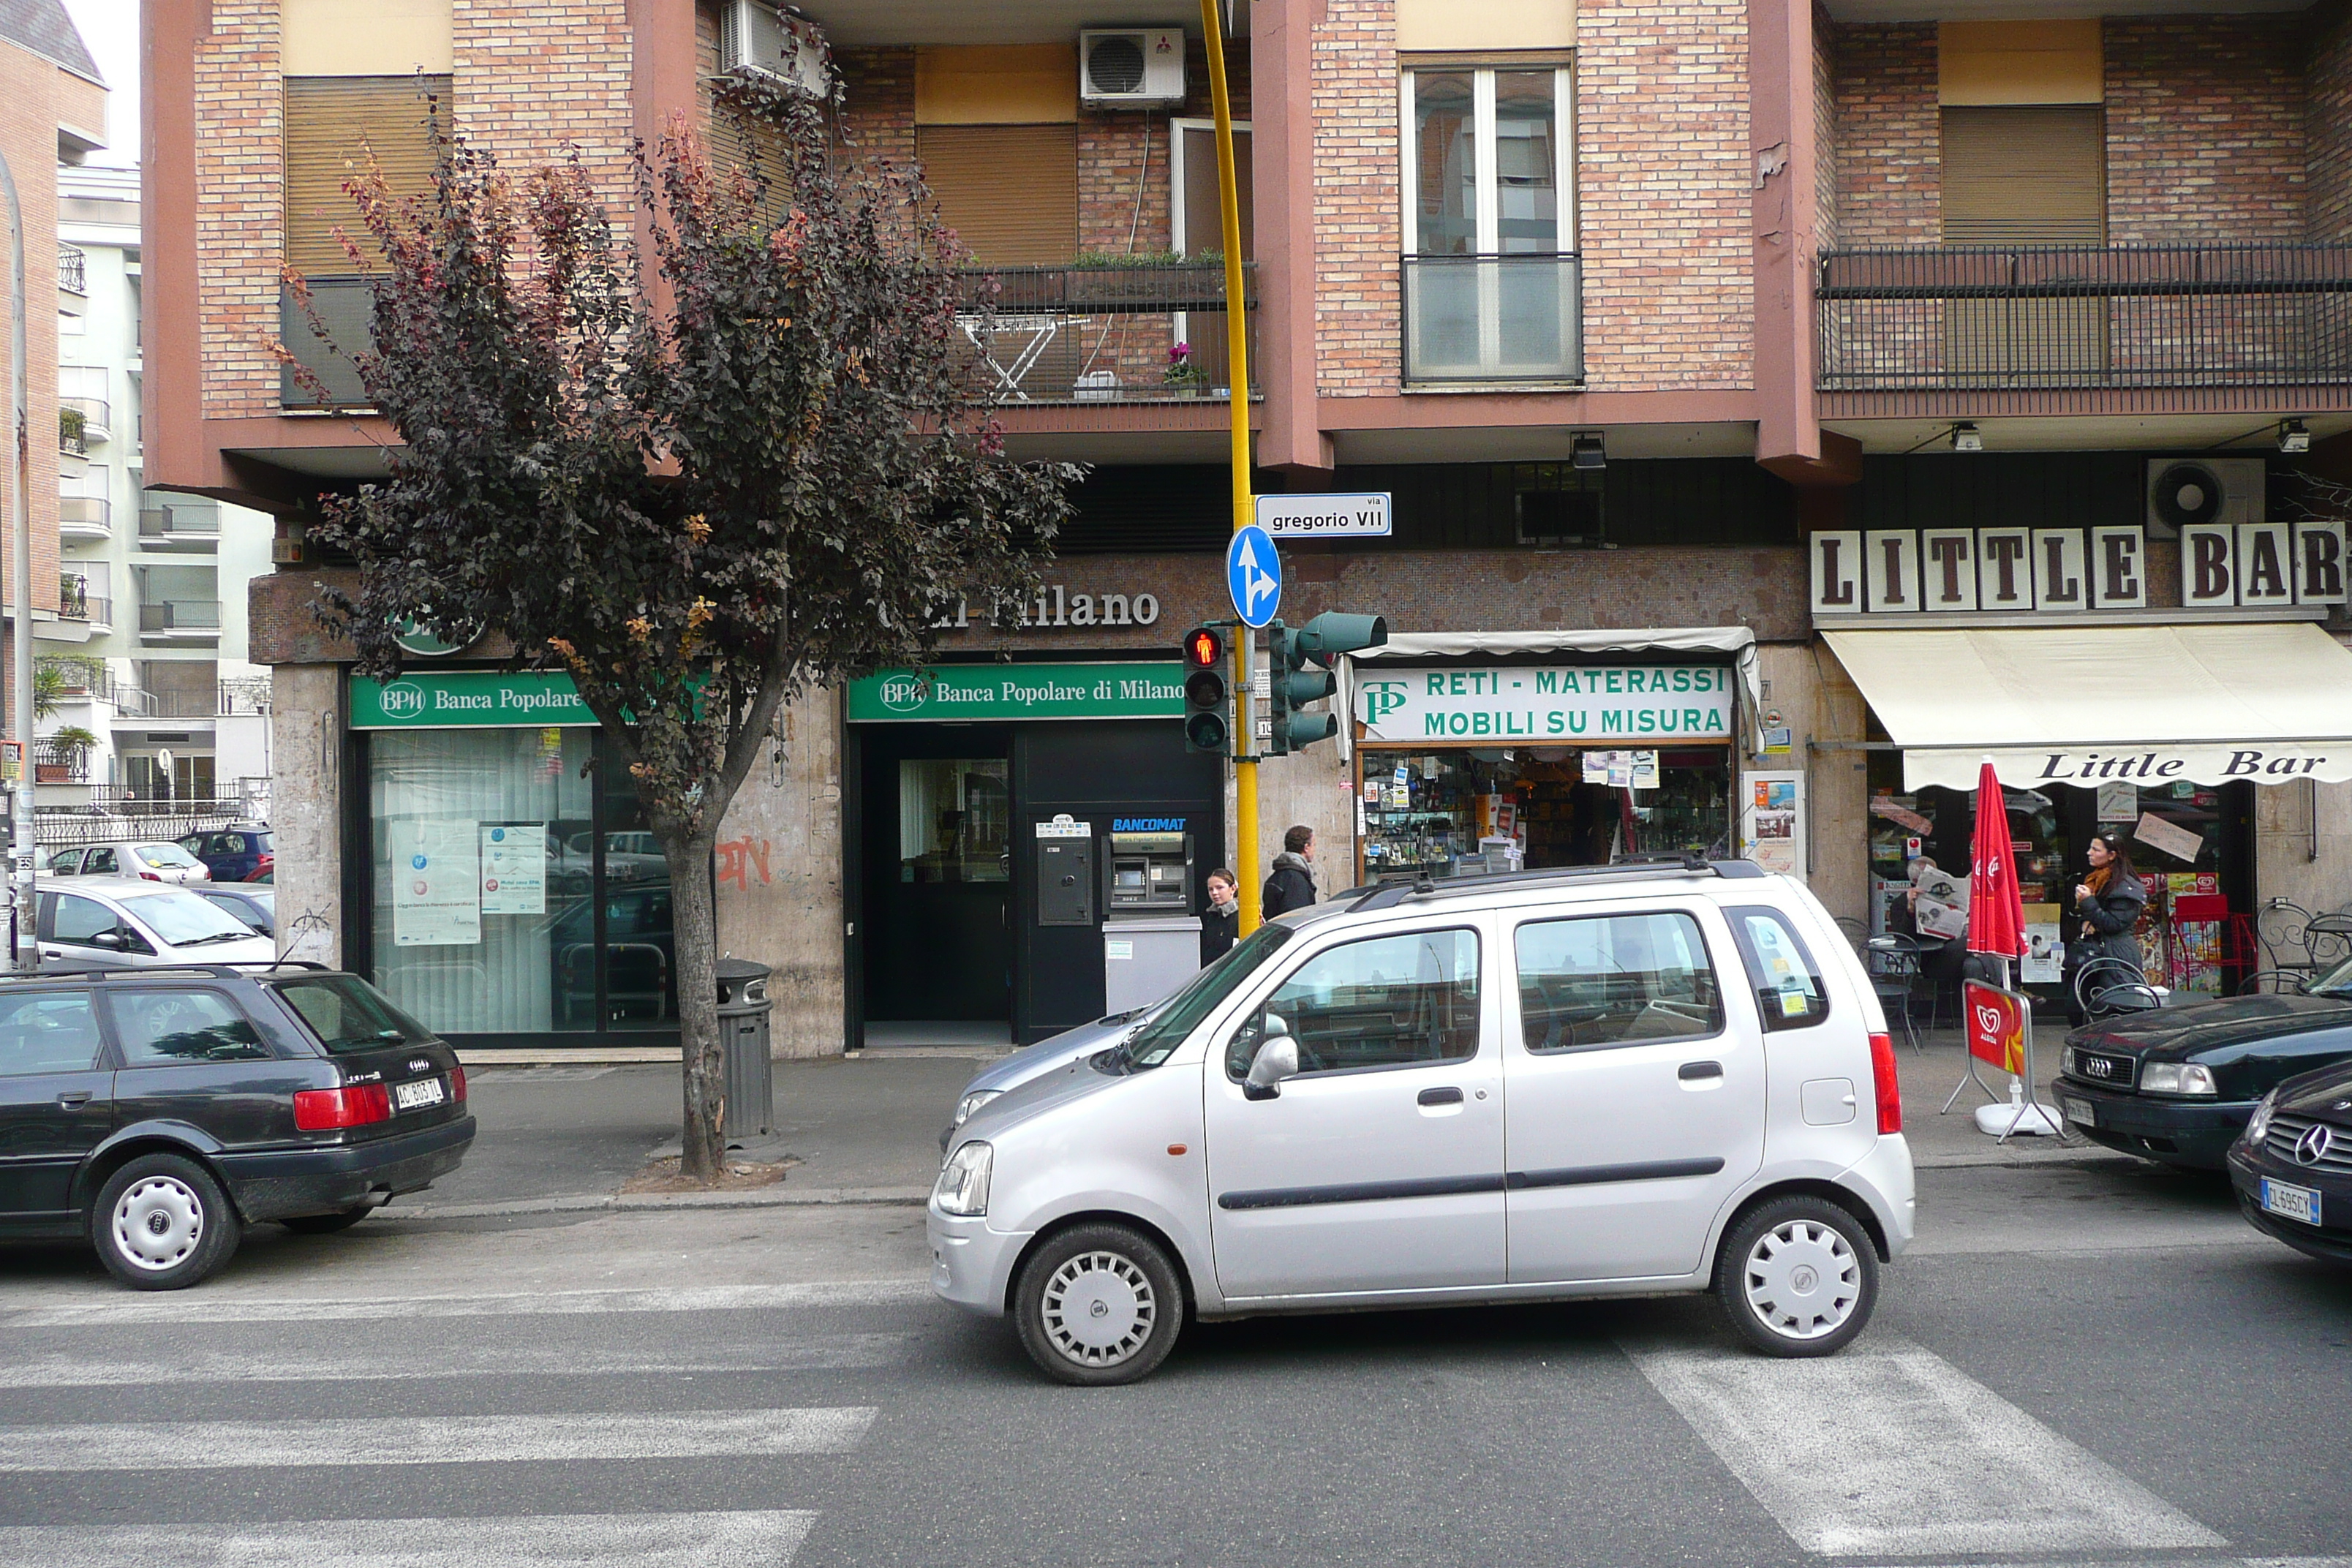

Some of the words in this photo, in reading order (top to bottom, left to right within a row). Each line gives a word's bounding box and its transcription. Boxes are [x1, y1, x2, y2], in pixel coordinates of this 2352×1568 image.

[1367, 497, 1381, 505] via
[1273, 513, 1349, 531] gregorio
[1357, 511, 1382, 527] VII
[1820, 534, 2138, 604] LITTLE
[2190, 530, 2343, 599] BAR
[935, 683, 995, 703] Banca
[1001, 681, 1086, 706] Popolare
[1093, 680, 1112, 700] di
[1119, 679, 1185, 700] Milano
[1426, 672, 1499, 696] RETI
[1535, 669, 1725, 695] MATERASSI
[434, 690, 492, 709] Banca
[500, 687, 583, 713] Popolare
[1425, 712, 1534, 736] MOBILI
[1547, 710, 1587, 734] SU
[1601, 708, 1725, 733] MISURA
[2035, 753, 2185, 780] Little
[2218, 750, 2326, 776] Bar
[1112, 818, 1186, 832] BANCOMAT
[399, 1086, 410, 1105] AC
[412, 1082, 428, 1101] 803
